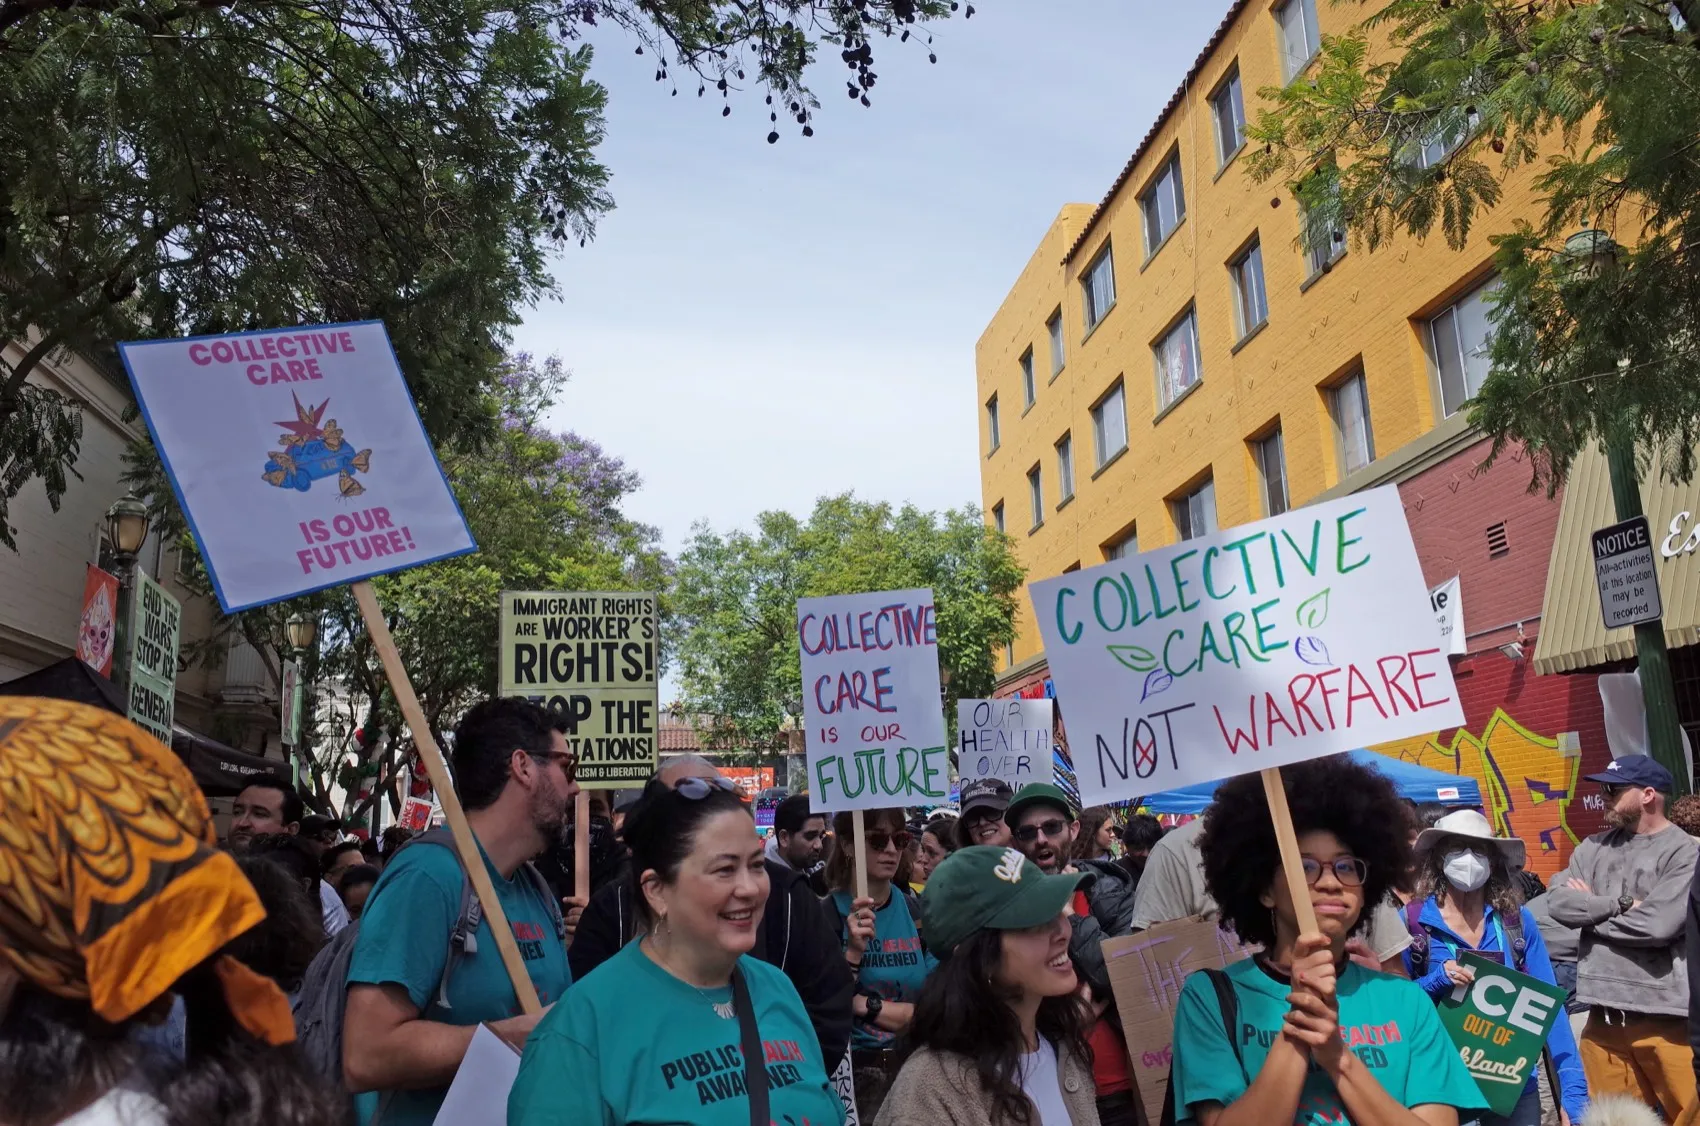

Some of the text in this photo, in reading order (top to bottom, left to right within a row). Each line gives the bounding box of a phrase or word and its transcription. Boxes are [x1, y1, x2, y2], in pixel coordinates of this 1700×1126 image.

[189, 332, 356, 366] COLLECTIVE
[246, 359, 323, 386] CARE
[299, 507, 394, 545] IS OUR
[1597, 526, 1646, 557] NOTICE
[296, 527, 417, 574] FUTURE!
[1056, 507, 1370, 645] COLLECTIVE
[1602, 570, 1652, 591] at this location
[143, 582, 177, 632] END THE
[513, 598, 653, 616] IMMIGRANT RIGHTS
[1613, 586, 1645, 602] may be
[1613, 602, 1649, 620] recorded
[515, 622, 538, 636] ARE
[800, 602, 937, 656] COLLECTIVE
[1163, 597, 1289, 677] CARE
[137, 636, 161, 672] STOP
[514, 642, 653, 684] RIGHTS!
[815, 666, 897, 715] CARE
[601, 700, 653, 734] THE
[974, 702, 1024, 728] OUR
[1096, 648, 1450, 788] NOT WARFARE
[565, 737, 653, 762] TATIONS!
[822, 723, 907, 744] IS OUR
[962, 729, 1048, 753] HEALTH
[599, 767, 605, 777] &
[606, 767, 651, 777] LIBERATION
[816, 746, 946, 804] FUTURE
[977, 756, 1031, 777] OVER
[1112, 935, 1195, 1012] THE
[1450, 964, 1556, 1036] ICE
[1463, 1013, 1516, 1047] OUT OF
[660, 1044, 741, 1090] PUBLIC
